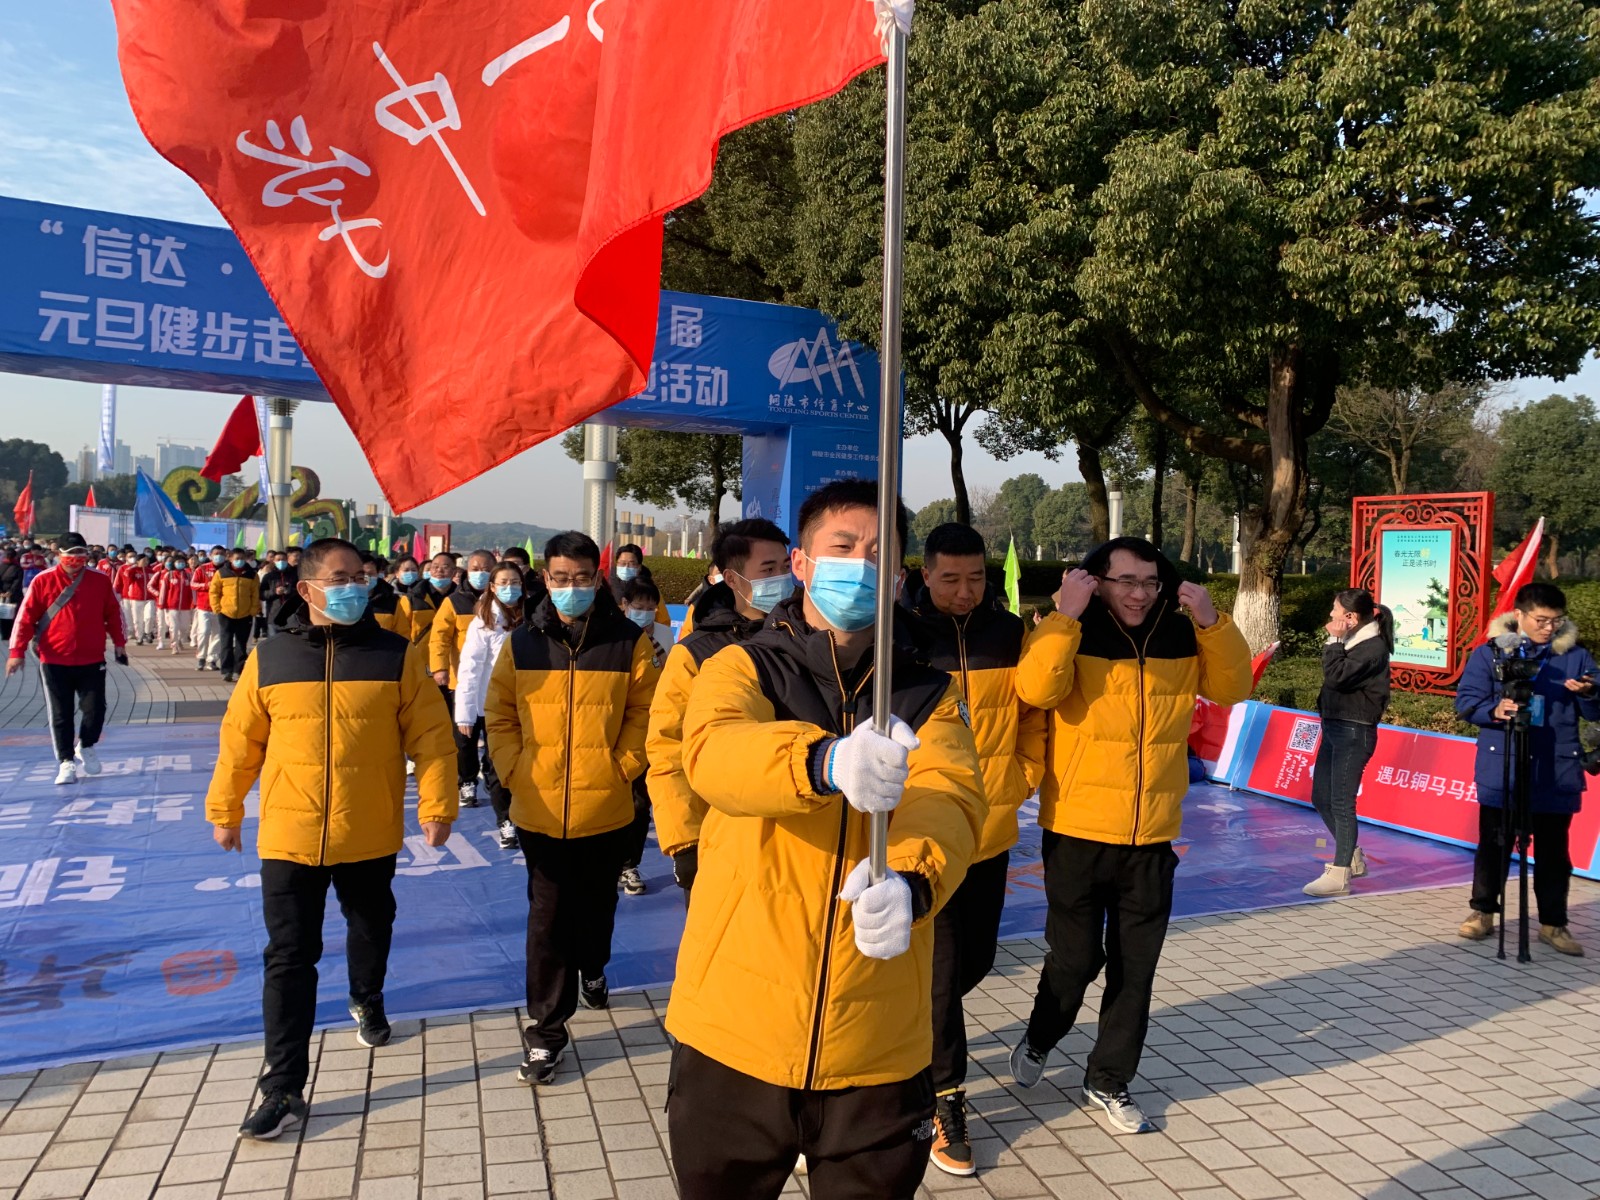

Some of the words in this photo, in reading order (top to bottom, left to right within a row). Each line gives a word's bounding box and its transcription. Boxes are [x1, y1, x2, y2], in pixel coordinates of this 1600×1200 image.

[38, 290, 311, 368] 元旦健步走
[768, 406, 809, 415] TONGLING
[810, 410, 838, 418] SPORTS
[839, 412, 870, 420] CENTER
[836, 444, 859, 452] 主办单位
